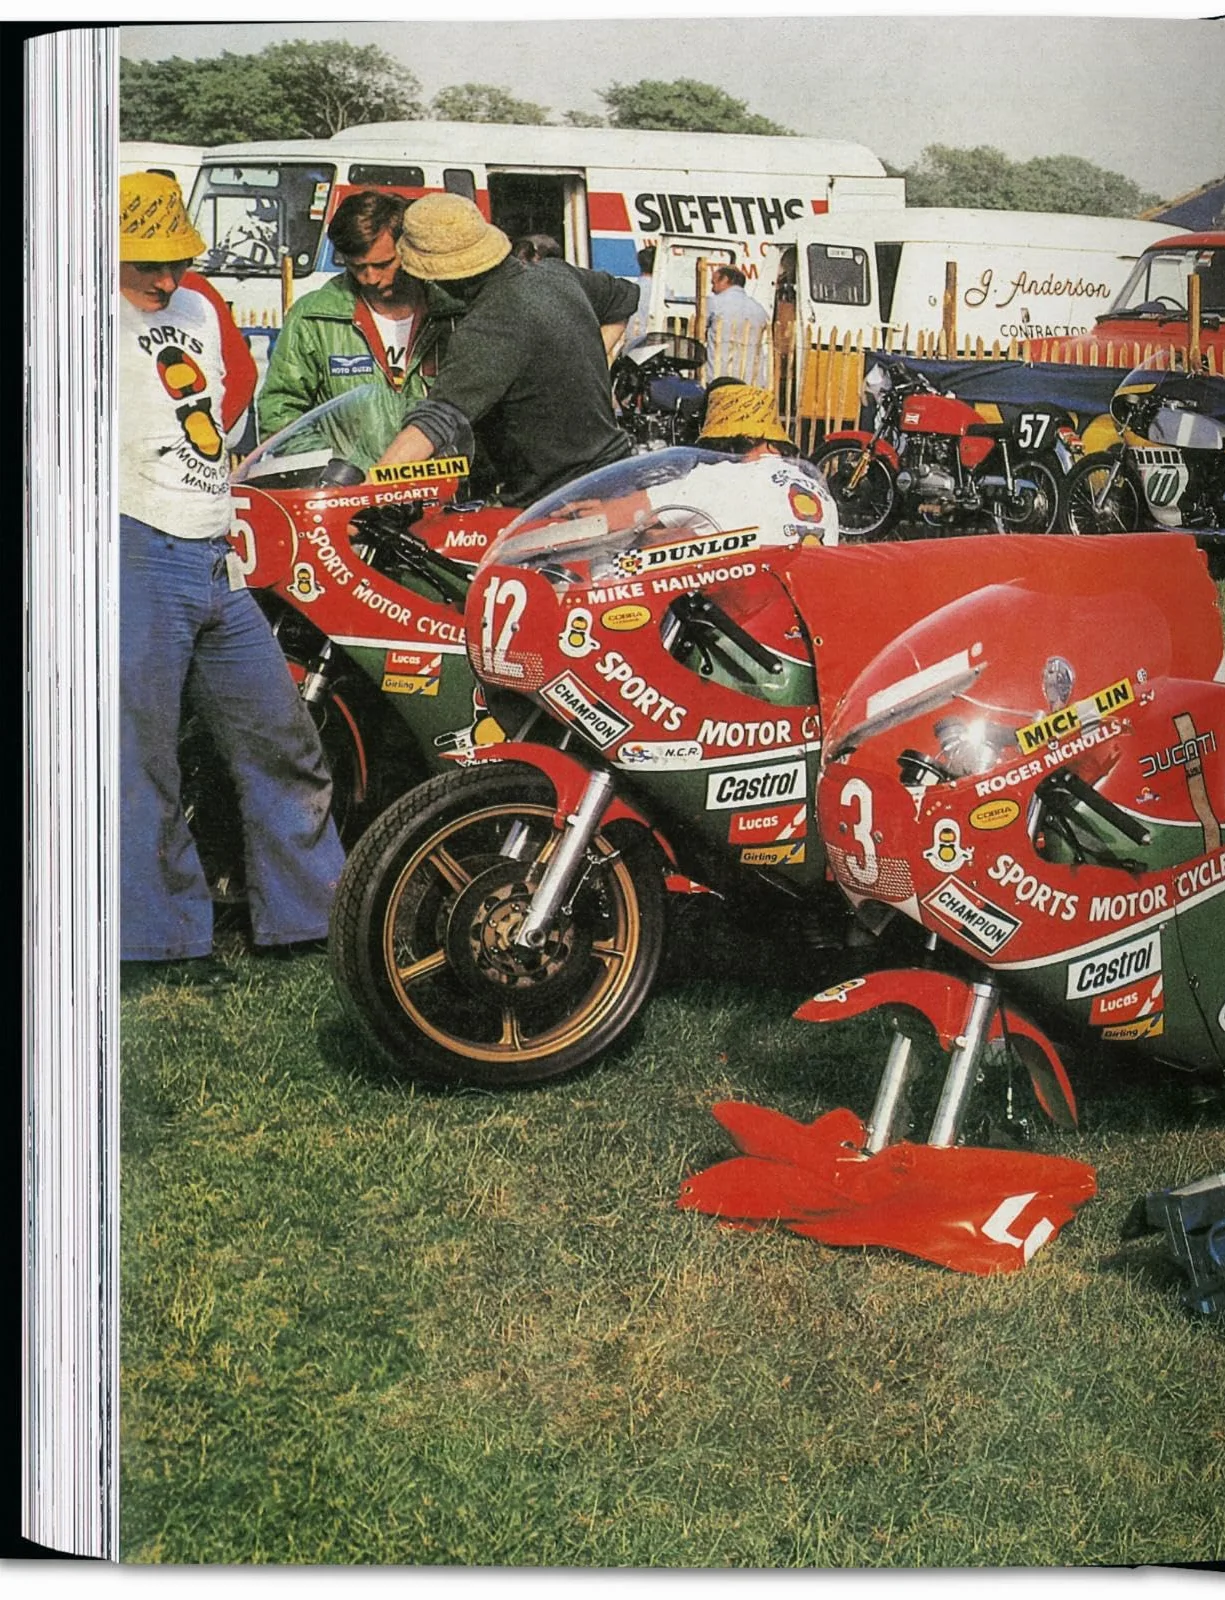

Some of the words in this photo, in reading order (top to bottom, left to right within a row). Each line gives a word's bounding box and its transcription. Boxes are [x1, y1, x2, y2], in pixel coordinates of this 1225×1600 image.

[995, 270, 1112, 308] Anderson
[138, 325, 204, 356] PORTS
[1018, 413, 1051, 449] 57
[375, 459, 466, 483] MICHELIN
[304, 494, 370, 511] GEORGE
[374, 486, 440, 504] FOGARTY
[444, 530, 488, 548] Moto
[646, 532, 758, 566] DUNLOP
[305, 525, 355, 586] SPORTS
[351, 580, 412, 626] MOTOR
[586, 583, 646, 605] MIKE
[652, 563, 757, 594] HAILWOOD
[483, 576, 528, 679] 12
[607, 611, 643, 621] COBRA
[391, 652, 421, 666] Lucas
[384, 679, 415, 691] Girling
[595, 650, 689, 732] SPORTS
[697, 719, 793, 748] MOTOR
[553, 683, 617, 741] CHAMPION
[1022, 683, 1130, 749] MICHLIN
[664, 747, 701, 758] N.C.R.
[974, 759, 1044, 797] ROGER
[1045, 718, 1123, 769] NICHOLLS
[1138, 730, 1219, 778] DUCATI
[715, 768, 799, 804] Castrol
[738, 815, 779, 832] Lucas
[839, 777, 878, 886] 3
[743, 851, 778, 864] Girling
[986, 854, 1080, 921] SPORTS
[1088, 884, 1168, 922] MOTOR
[937, 891, 1006, 942] CHAMPION
[1076, 941, 1154, 993] Castrol
[1099, 991, 1139, 1013] Lucas
[1104, 1028, 1139, 1040] Girling
